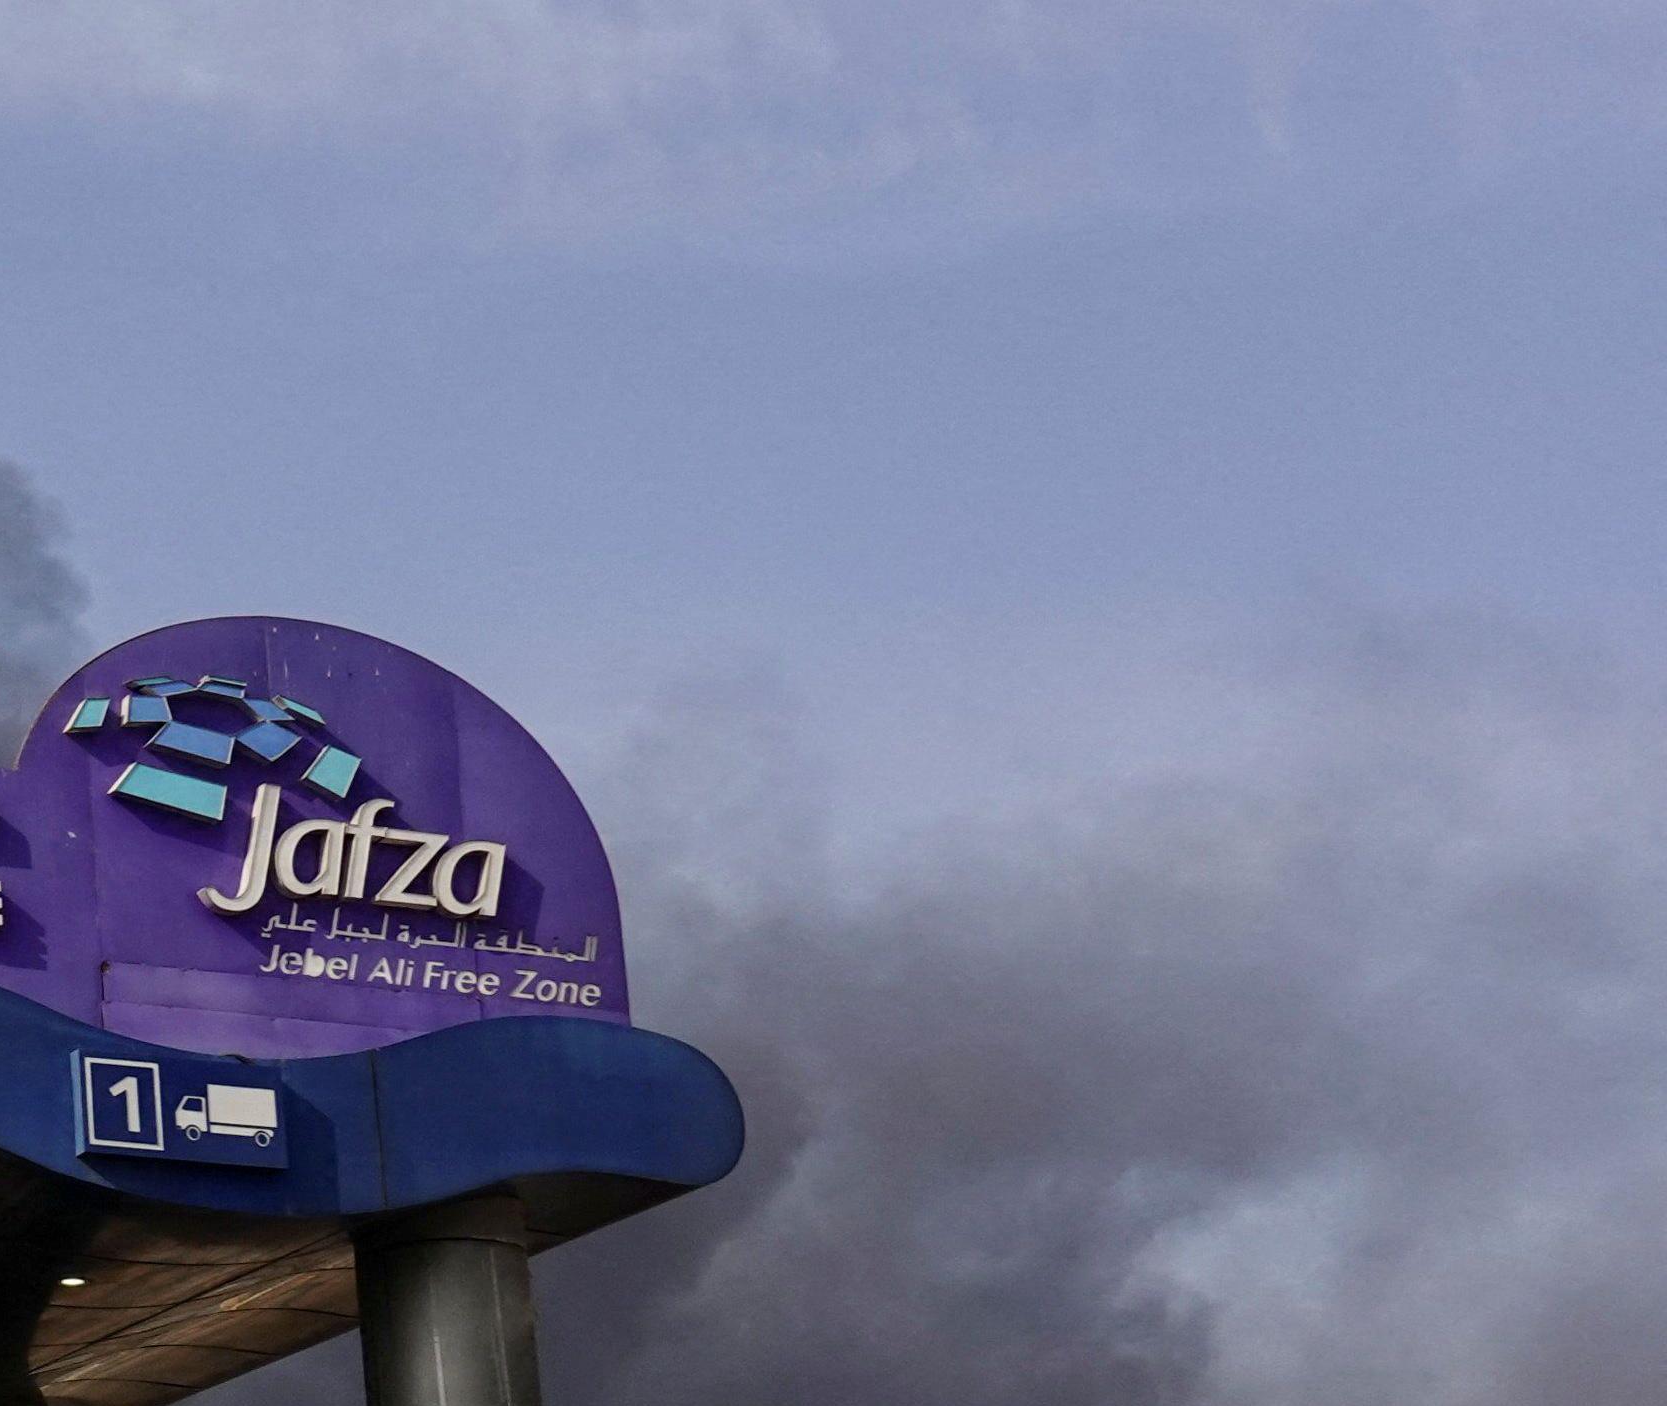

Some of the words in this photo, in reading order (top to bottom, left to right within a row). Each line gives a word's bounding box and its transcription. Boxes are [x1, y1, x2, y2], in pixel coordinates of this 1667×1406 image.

[196, 783, 507, 918] Jafza
[259, 943, 359, 982] Jebel
[367, 956, 414, 987] Ali
[421, 961, 501, 997] Free
[509, 969, 603, 1007] Zone
[109, 1076, 141, 1133] 1
